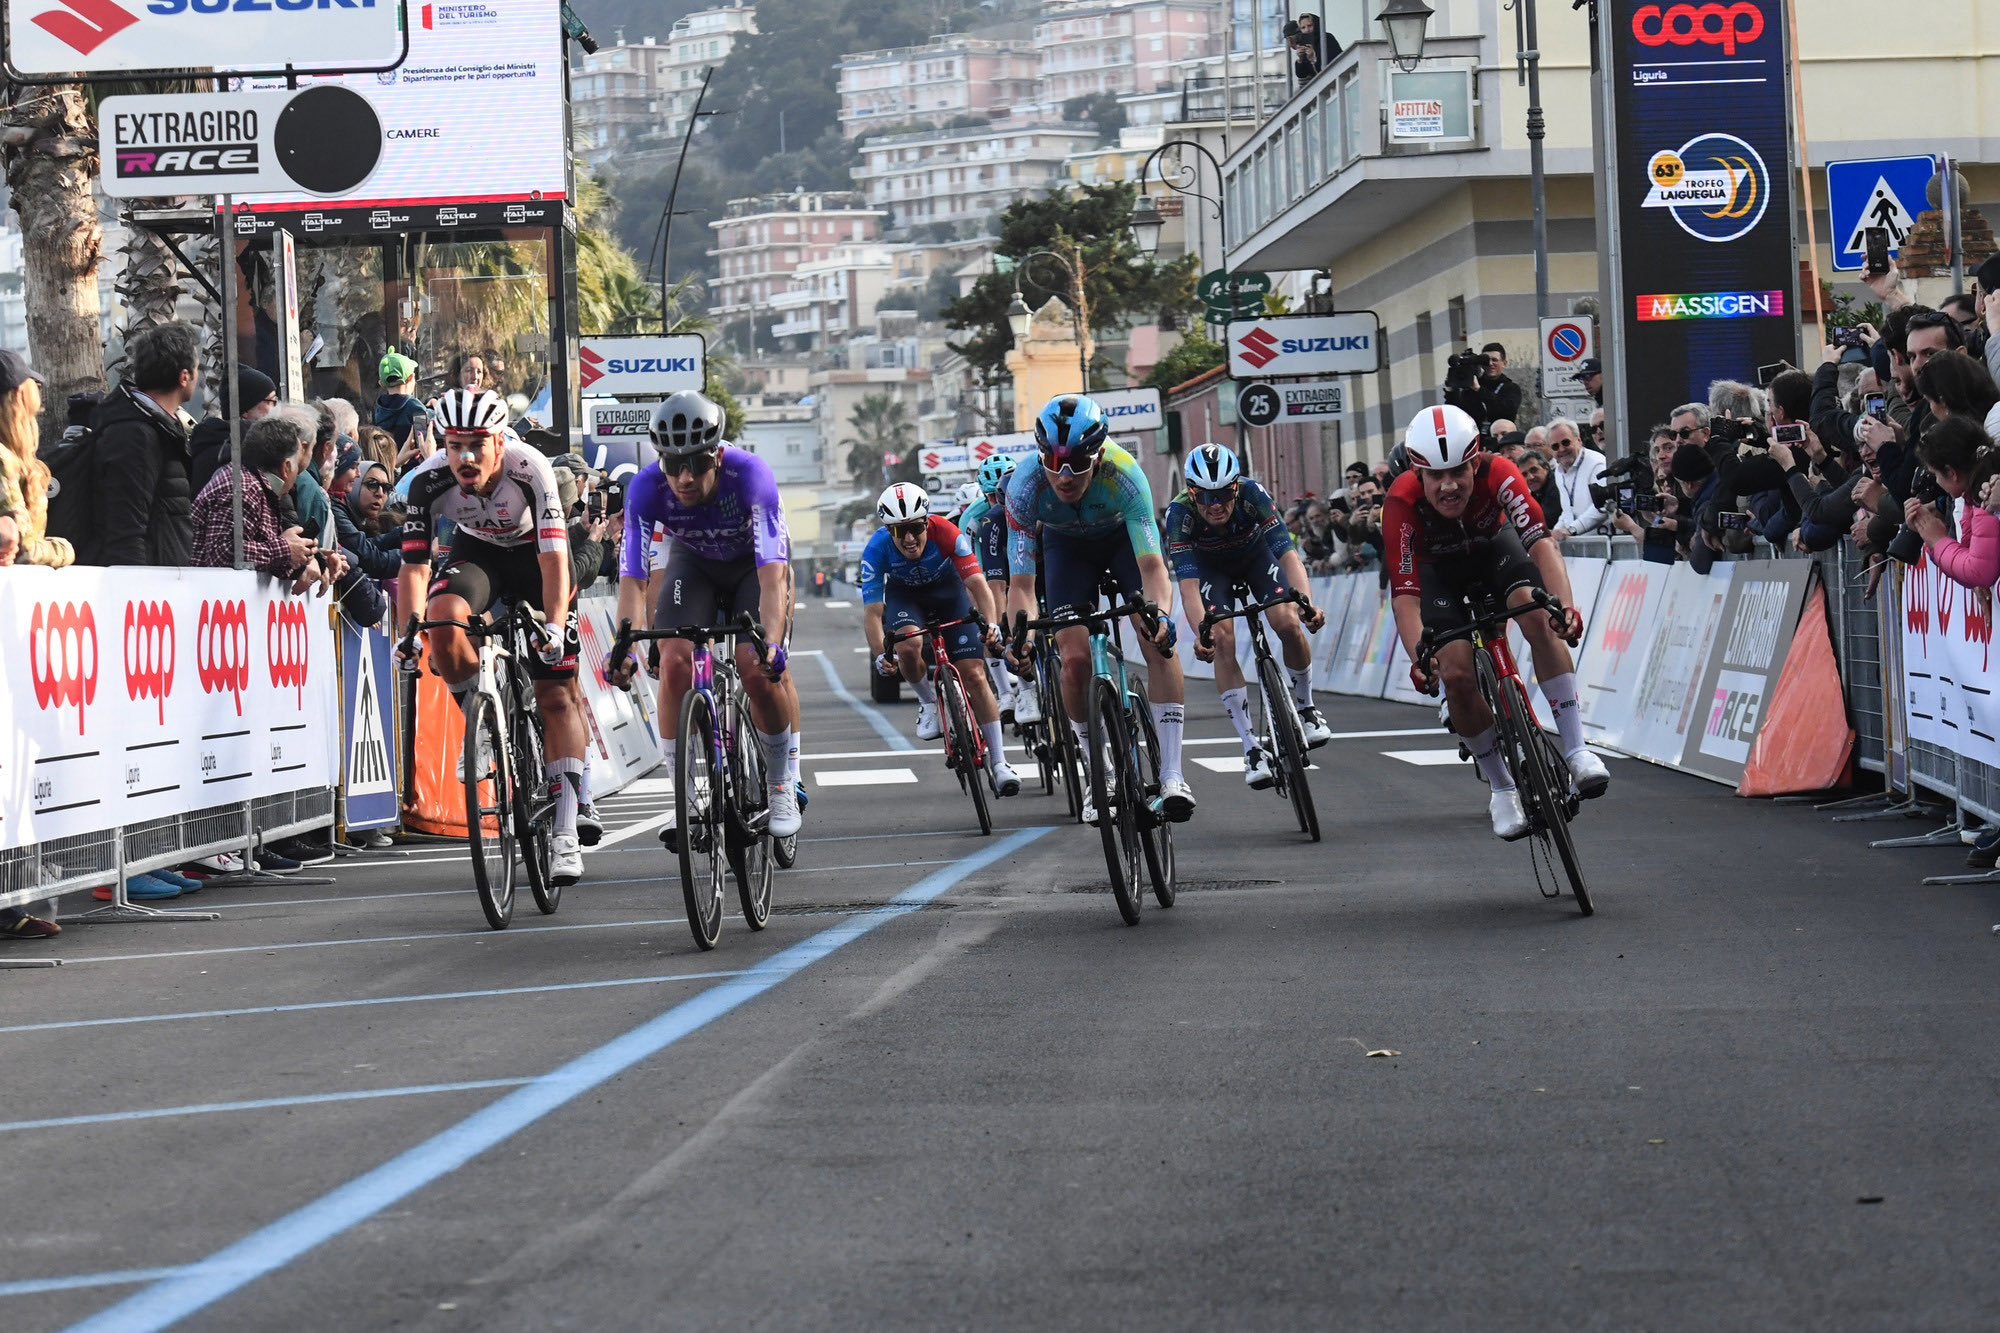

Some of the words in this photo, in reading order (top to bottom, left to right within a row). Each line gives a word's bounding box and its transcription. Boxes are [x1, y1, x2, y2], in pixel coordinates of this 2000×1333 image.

[438, 4, 486, 12] MINISTERO
[438, 12, 456, 20] DEL
[459, 10, 498, 19] TURISMO
[1632, 2, 1764, 55] coop
[403, 67, 443, 75] Presidenza
[445, 65, 457, 73] del
[458, 65, 492, 74] Consiglio
[493, 63, 506, 71] dei
[507, 62, 536, 70] Ministri
[1632, 70, 1668, 81] Liguria
[403, 74, 452, 83] Dipartimento
[476, 72, 491, 80] pari
[492, 70, 536, 79] opportunità
[114, 110, 259, 144] EXTRAGIRO
[116, 149, 259, 172] RACE
[1685, 179, 1725, 189] TROFEO
[1660, 188, 1726, 201] LAIGUEGLIA
[301, 218, 343, 226] ITALTELO
[369, 215, 410, 223] ITALTELO
[436, 212, 477, 220] ITALTELO
[234, 220, 275, 228] ITALTELO
[1651, 294, 1770, 317] MASSIGEN
[1281, 335, 1369, 353] SUZUKI
[607, 357, 695, 373] SUZUKI
[1286, 388, 1341, 403] EXTRAGIRO
[1104, 403, 1155, 417] UZUKI
[1250, 394, 1270, 416] 25
[1289, 403, 1341, 413] RACE
[596, 409, 650, 424] EXTRAGIRO
[598, 424, 650, 434] RACE
[1497, 475, 1530, 528] lotto
[987, 568, 1003, 576] SGS
[674, 579, 682, 606] CADEX
[1723, 581, 1790, 669] EXTRAGIRO
[124, 599, 176, 726] coop
[197, 599, 249, 717] coop
[267, 599, 308, 711] coop
[30, 600, 98, 736] coop
[1707, 688, 1760, 743] RACE
[201, 749, 217, 776] Liguria
